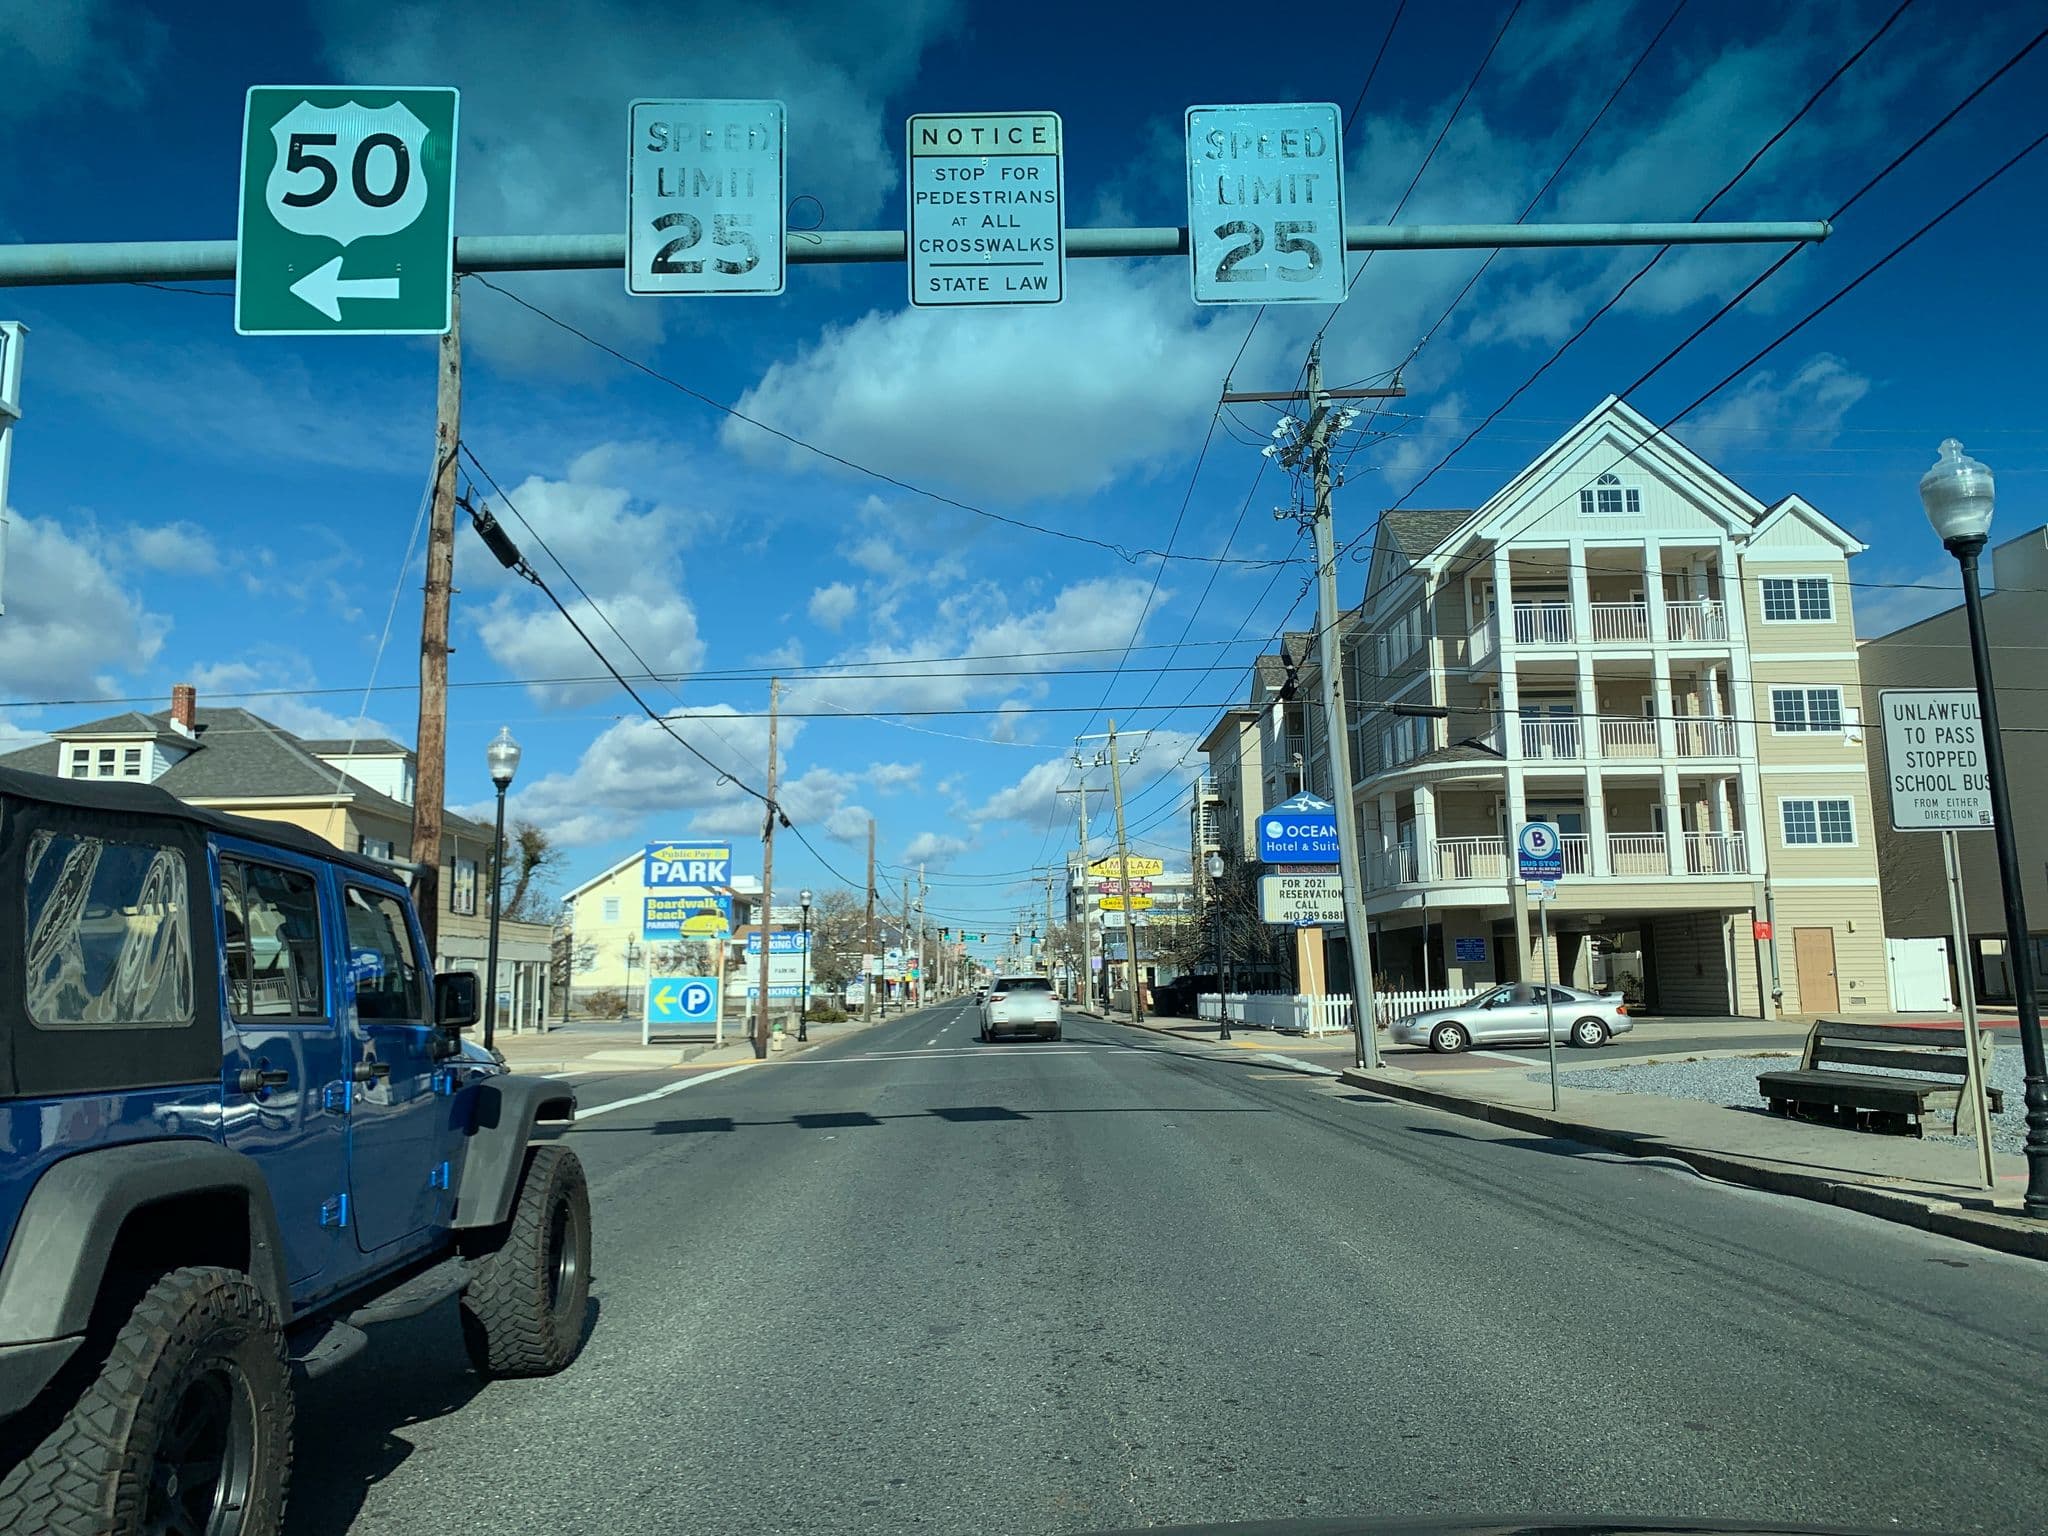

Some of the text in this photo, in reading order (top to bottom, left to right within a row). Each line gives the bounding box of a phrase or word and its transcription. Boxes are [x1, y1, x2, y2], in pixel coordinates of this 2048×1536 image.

[647, 122, 770, 152] SPEED
[922, 127, 1046, 145] NOTICE
[1205, 127, 1326, 160] SPEED
[282, 132, 410, 208] 50
[935, 167, 1039, 181] STOP FOR
[657, 167, 757, 198] LIMIT
[1218, 173, 1319, 205] LIMIT
[916, 190, 1055, 205] PEDESTRIANS
[952, 214, 1021, 228] AT ALL
[651, 212, 760, 275] 25
[919, 237, 1055, 253] CROSSWALKS
[1213, 221, 1323, 282] 25
[929, 276, 1048, 292] STATE LAW
[1893, 703, 1982, 721] UNLAWFUL
[1904, 726, 1975, 744] TO PASS
[1906, 750, 1977, 769] STOPPED
[1895, 773, 1991, 792] SCHOOL BUS
[1914, 797, 1979, 808] FROM EITHER
[1924, 809, 1973, 820] DIRECTION
[1286, 825, 1338, 838] OCEAN
[1532, 831, 1546, 847] B
[662, 850, 692, 858] Public
[1266, 841, 1298, 852] Hotel
[1302, 842, 1309, 851] &
[650, 861, 726, 883] PARK
[1282, 879, 1326, 888] FOR 2021
[647, 898, 728, 909] Boardwalk &
[1295, 900, 1319, 909] CALL
[647, 909, 686, 920] Beach
[1283, 911, 1343, 920] 410 289 6881
[646, 921, 680, 929] PARKING
[750, 940, 792, 950] PAKING
[687, 989, 706, 1010] P
